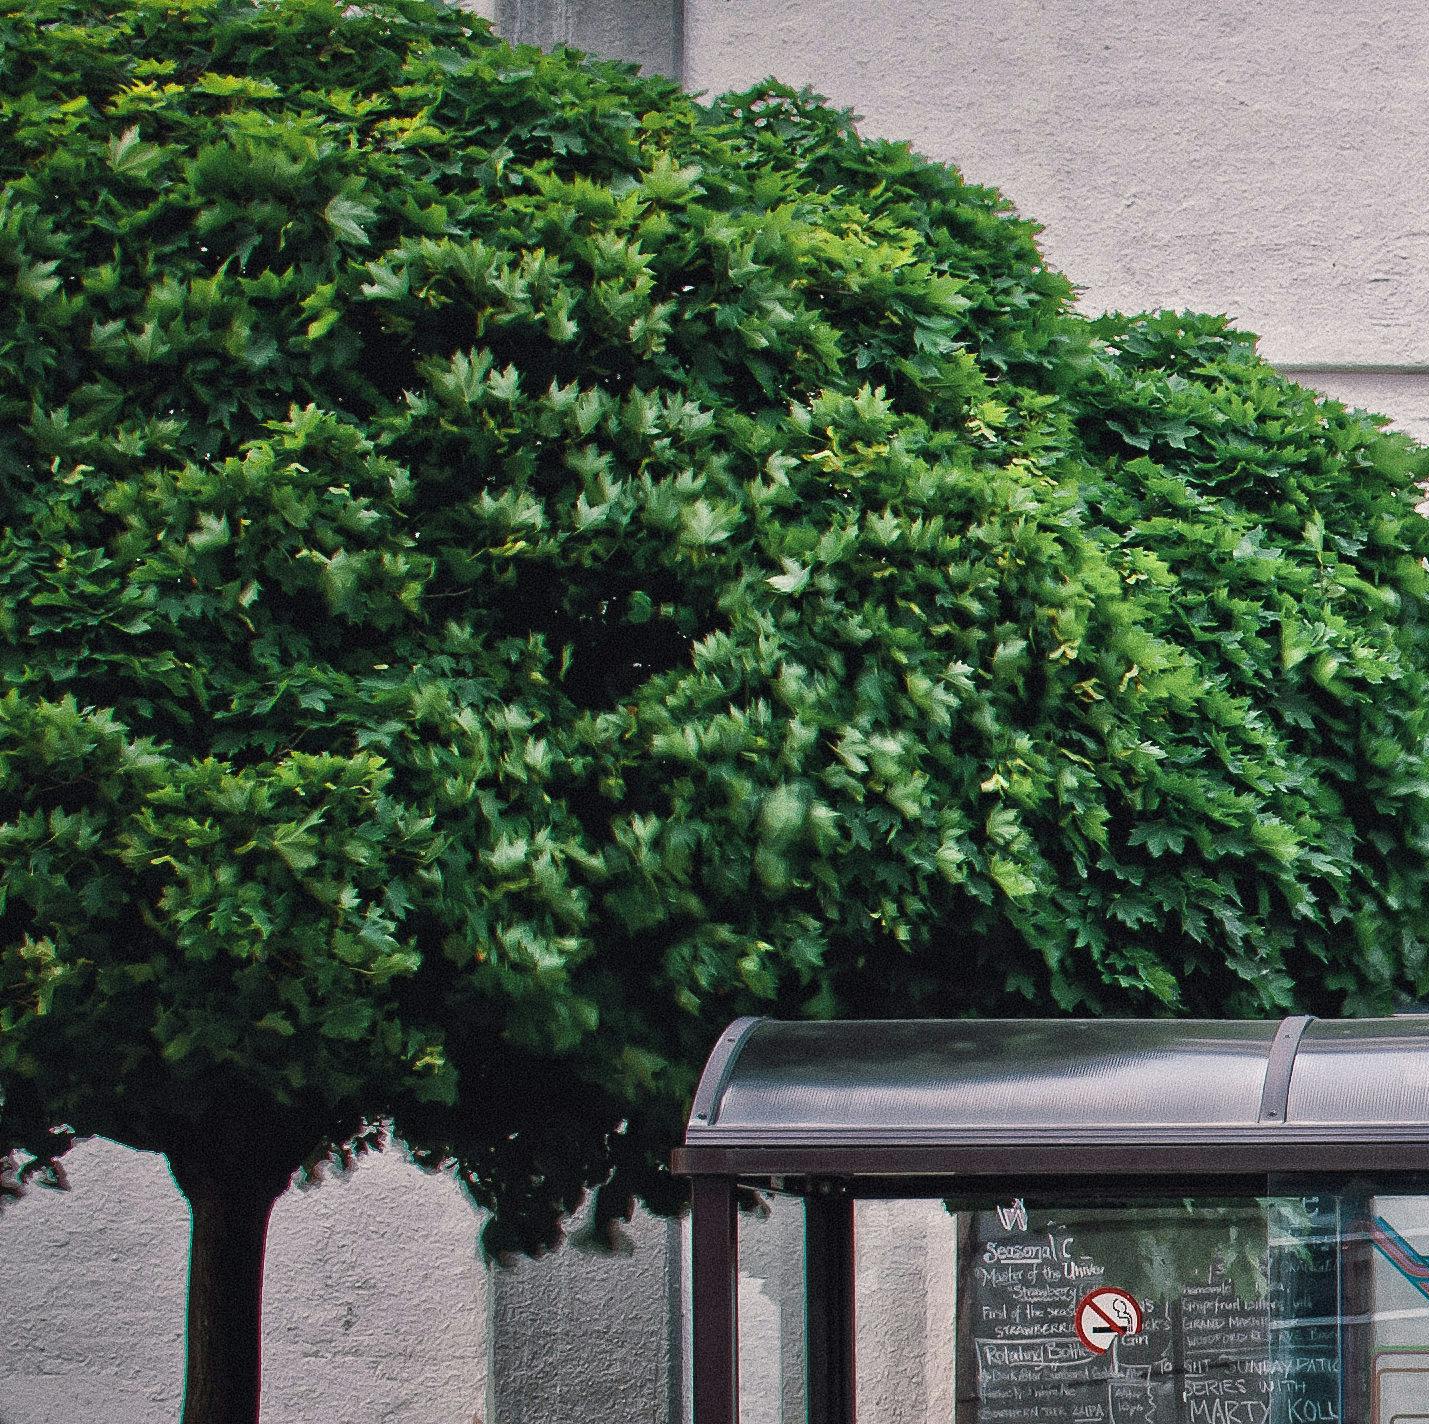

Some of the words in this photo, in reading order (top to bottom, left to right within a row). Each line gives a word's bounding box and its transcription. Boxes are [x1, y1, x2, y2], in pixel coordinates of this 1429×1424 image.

[982, 1233, 1058, 1264] Seasonal
[1185, 1379, 1247, 1396] SERIES
[1259, 1379, 1306, 1394] WITH
